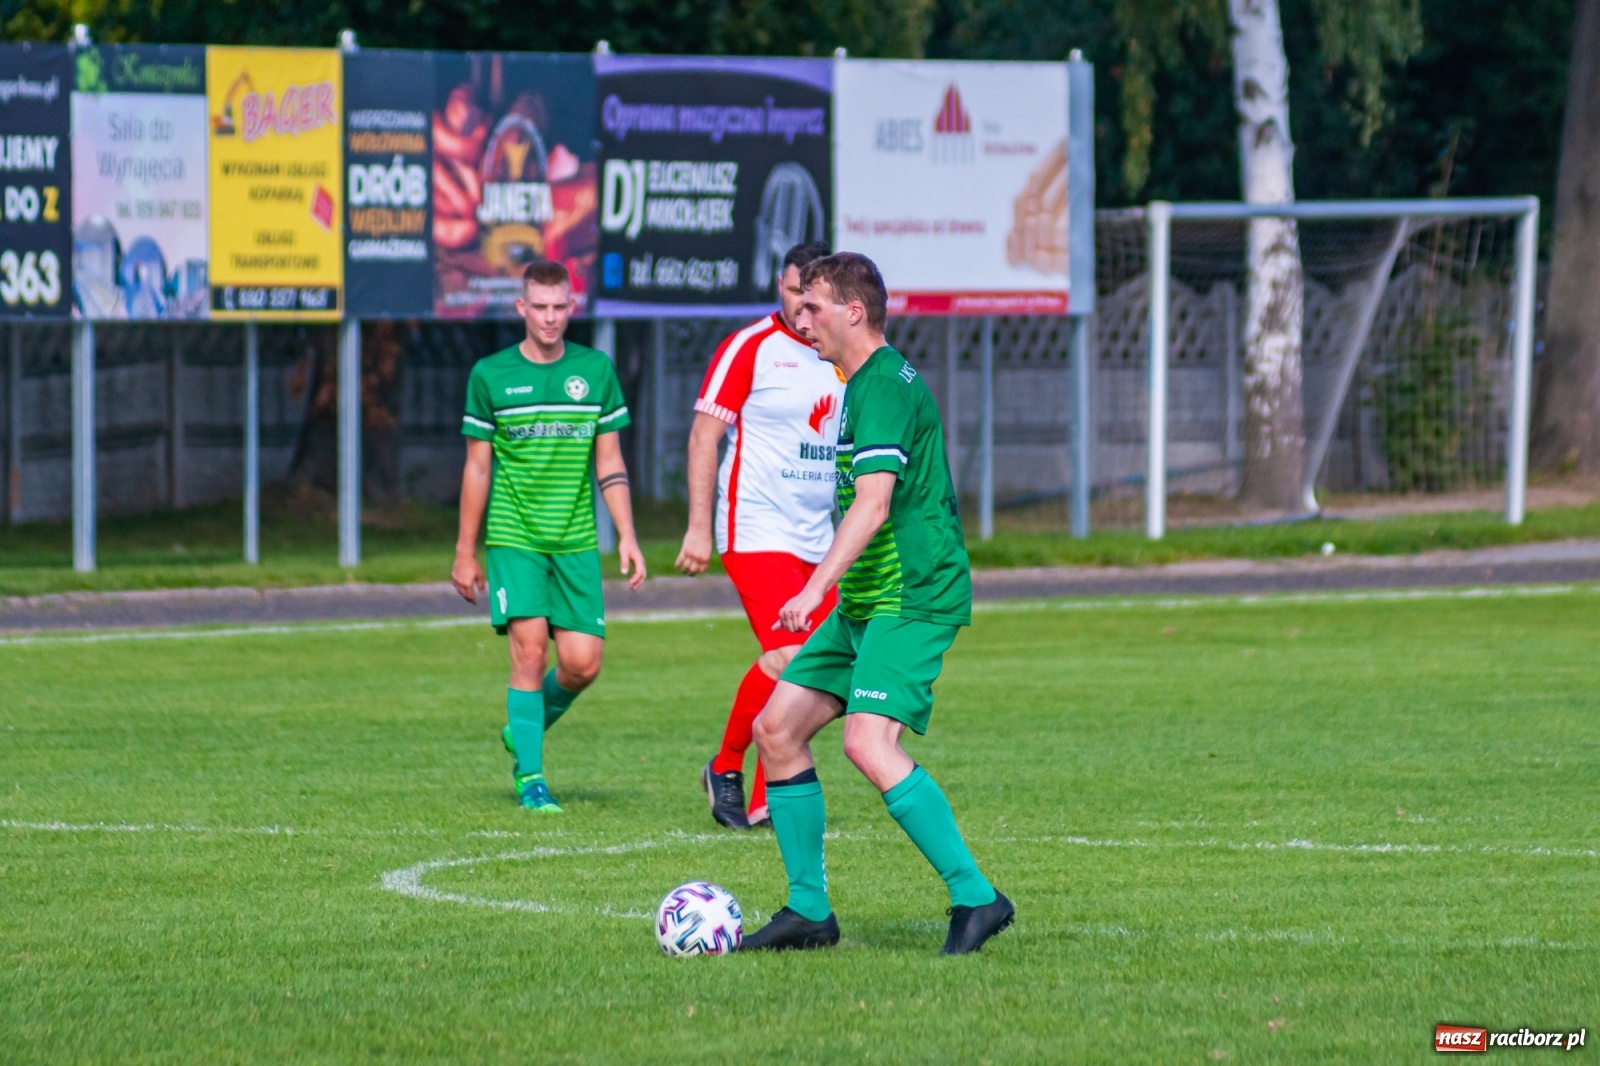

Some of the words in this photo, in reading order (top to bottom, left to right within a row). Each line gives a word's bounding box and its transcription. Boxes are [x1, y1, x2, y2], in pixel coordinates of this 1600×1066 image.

[107, 112, 145, 141] Sala
[149, 114, 174, 143] do
[242, 81, 337, 142] BAGER
[349, 153, 427, 207] DRÓB
[478, 183, 553, 222] JANETA
[603, 159, 647, 240] DJ
[5, 186, 39, 221] DO
[43, 187, 59, 220] Z
[1, 251, 60, 304] 363
[781, 468, 822, 482] GALERIA
